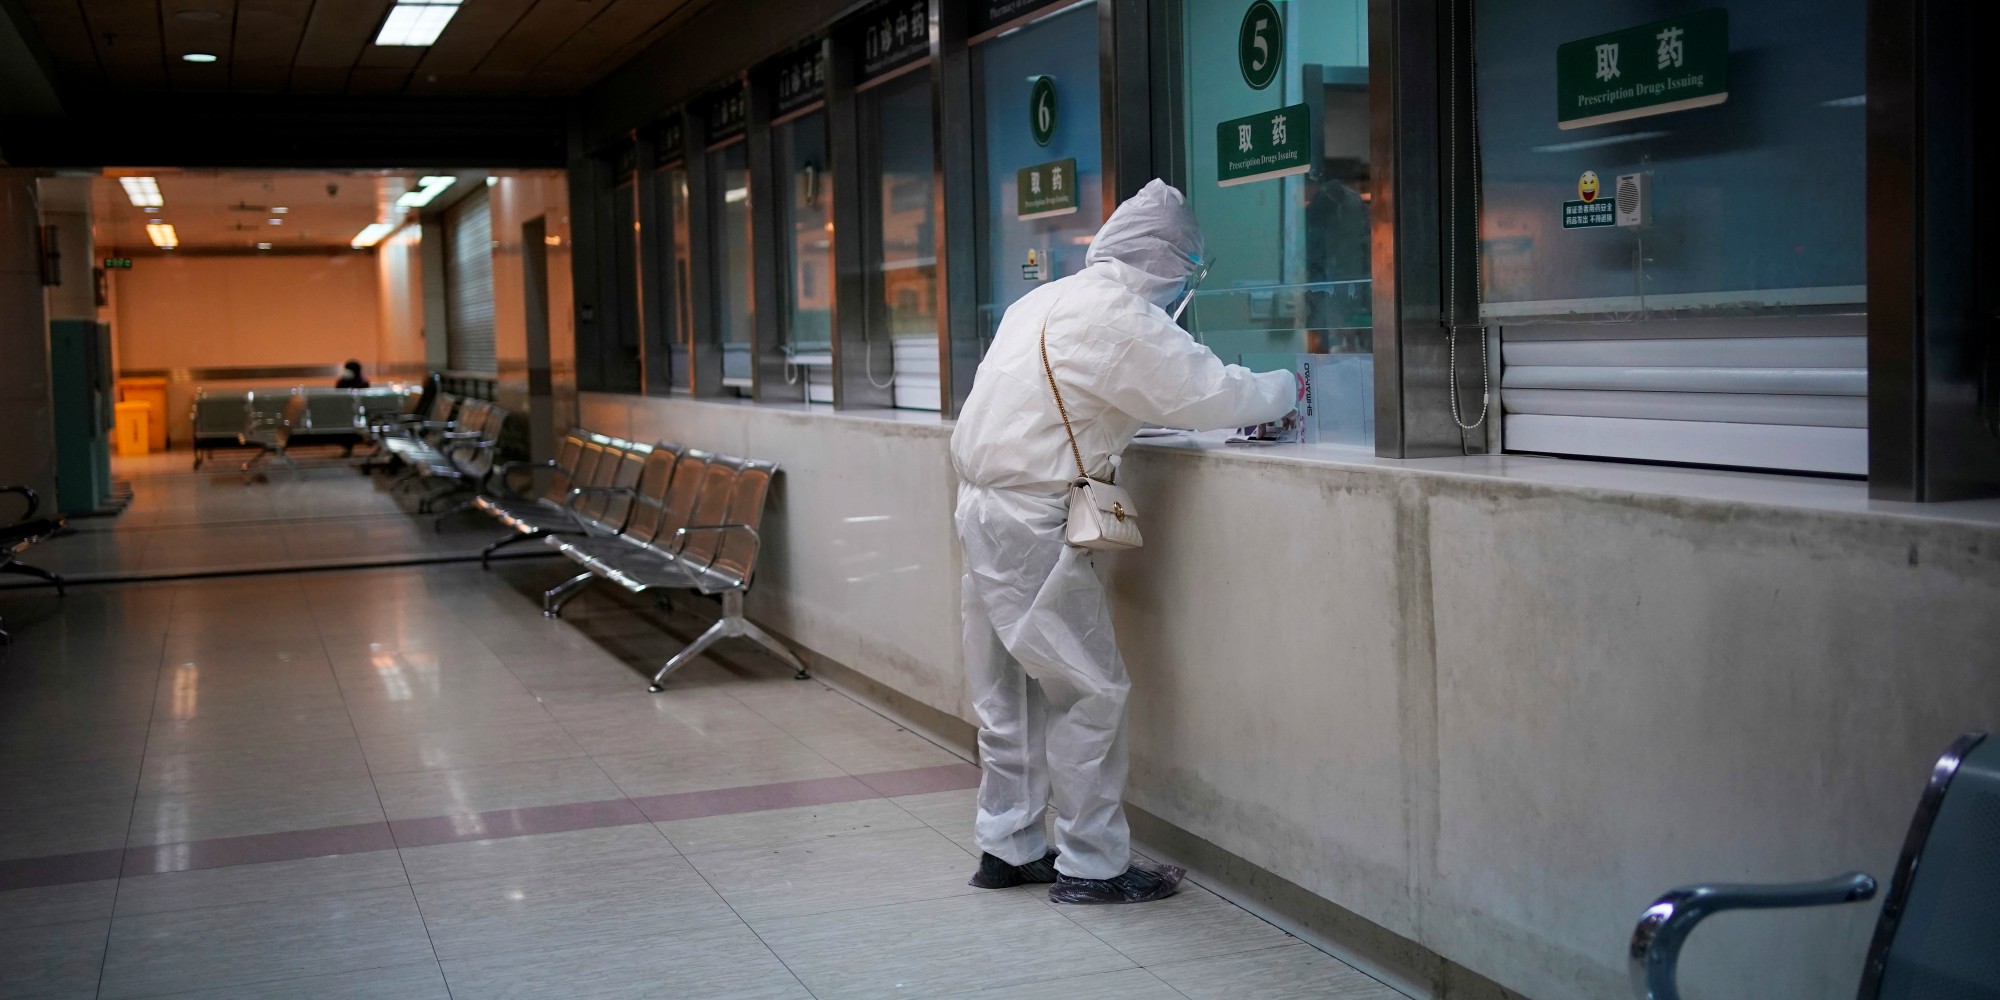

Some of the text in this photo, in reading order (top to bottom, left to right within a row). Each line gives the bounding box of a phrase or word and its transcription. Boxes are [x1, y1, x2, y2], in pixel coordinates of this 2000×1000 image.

[1252, 18, 1268, 71] 5
[1595, 26, 1684, 83] 取药
[1038, 90, 1050, 133] 6
[1577, 73, 1704, 107] Prescription Drugs Issuing
[1238, 114, 1287, 153] 取药
[1229, 149, 1298, 170] Prescription Drugs Issuing
[1304, 362, 1312, 416] SHIMAIYAO
